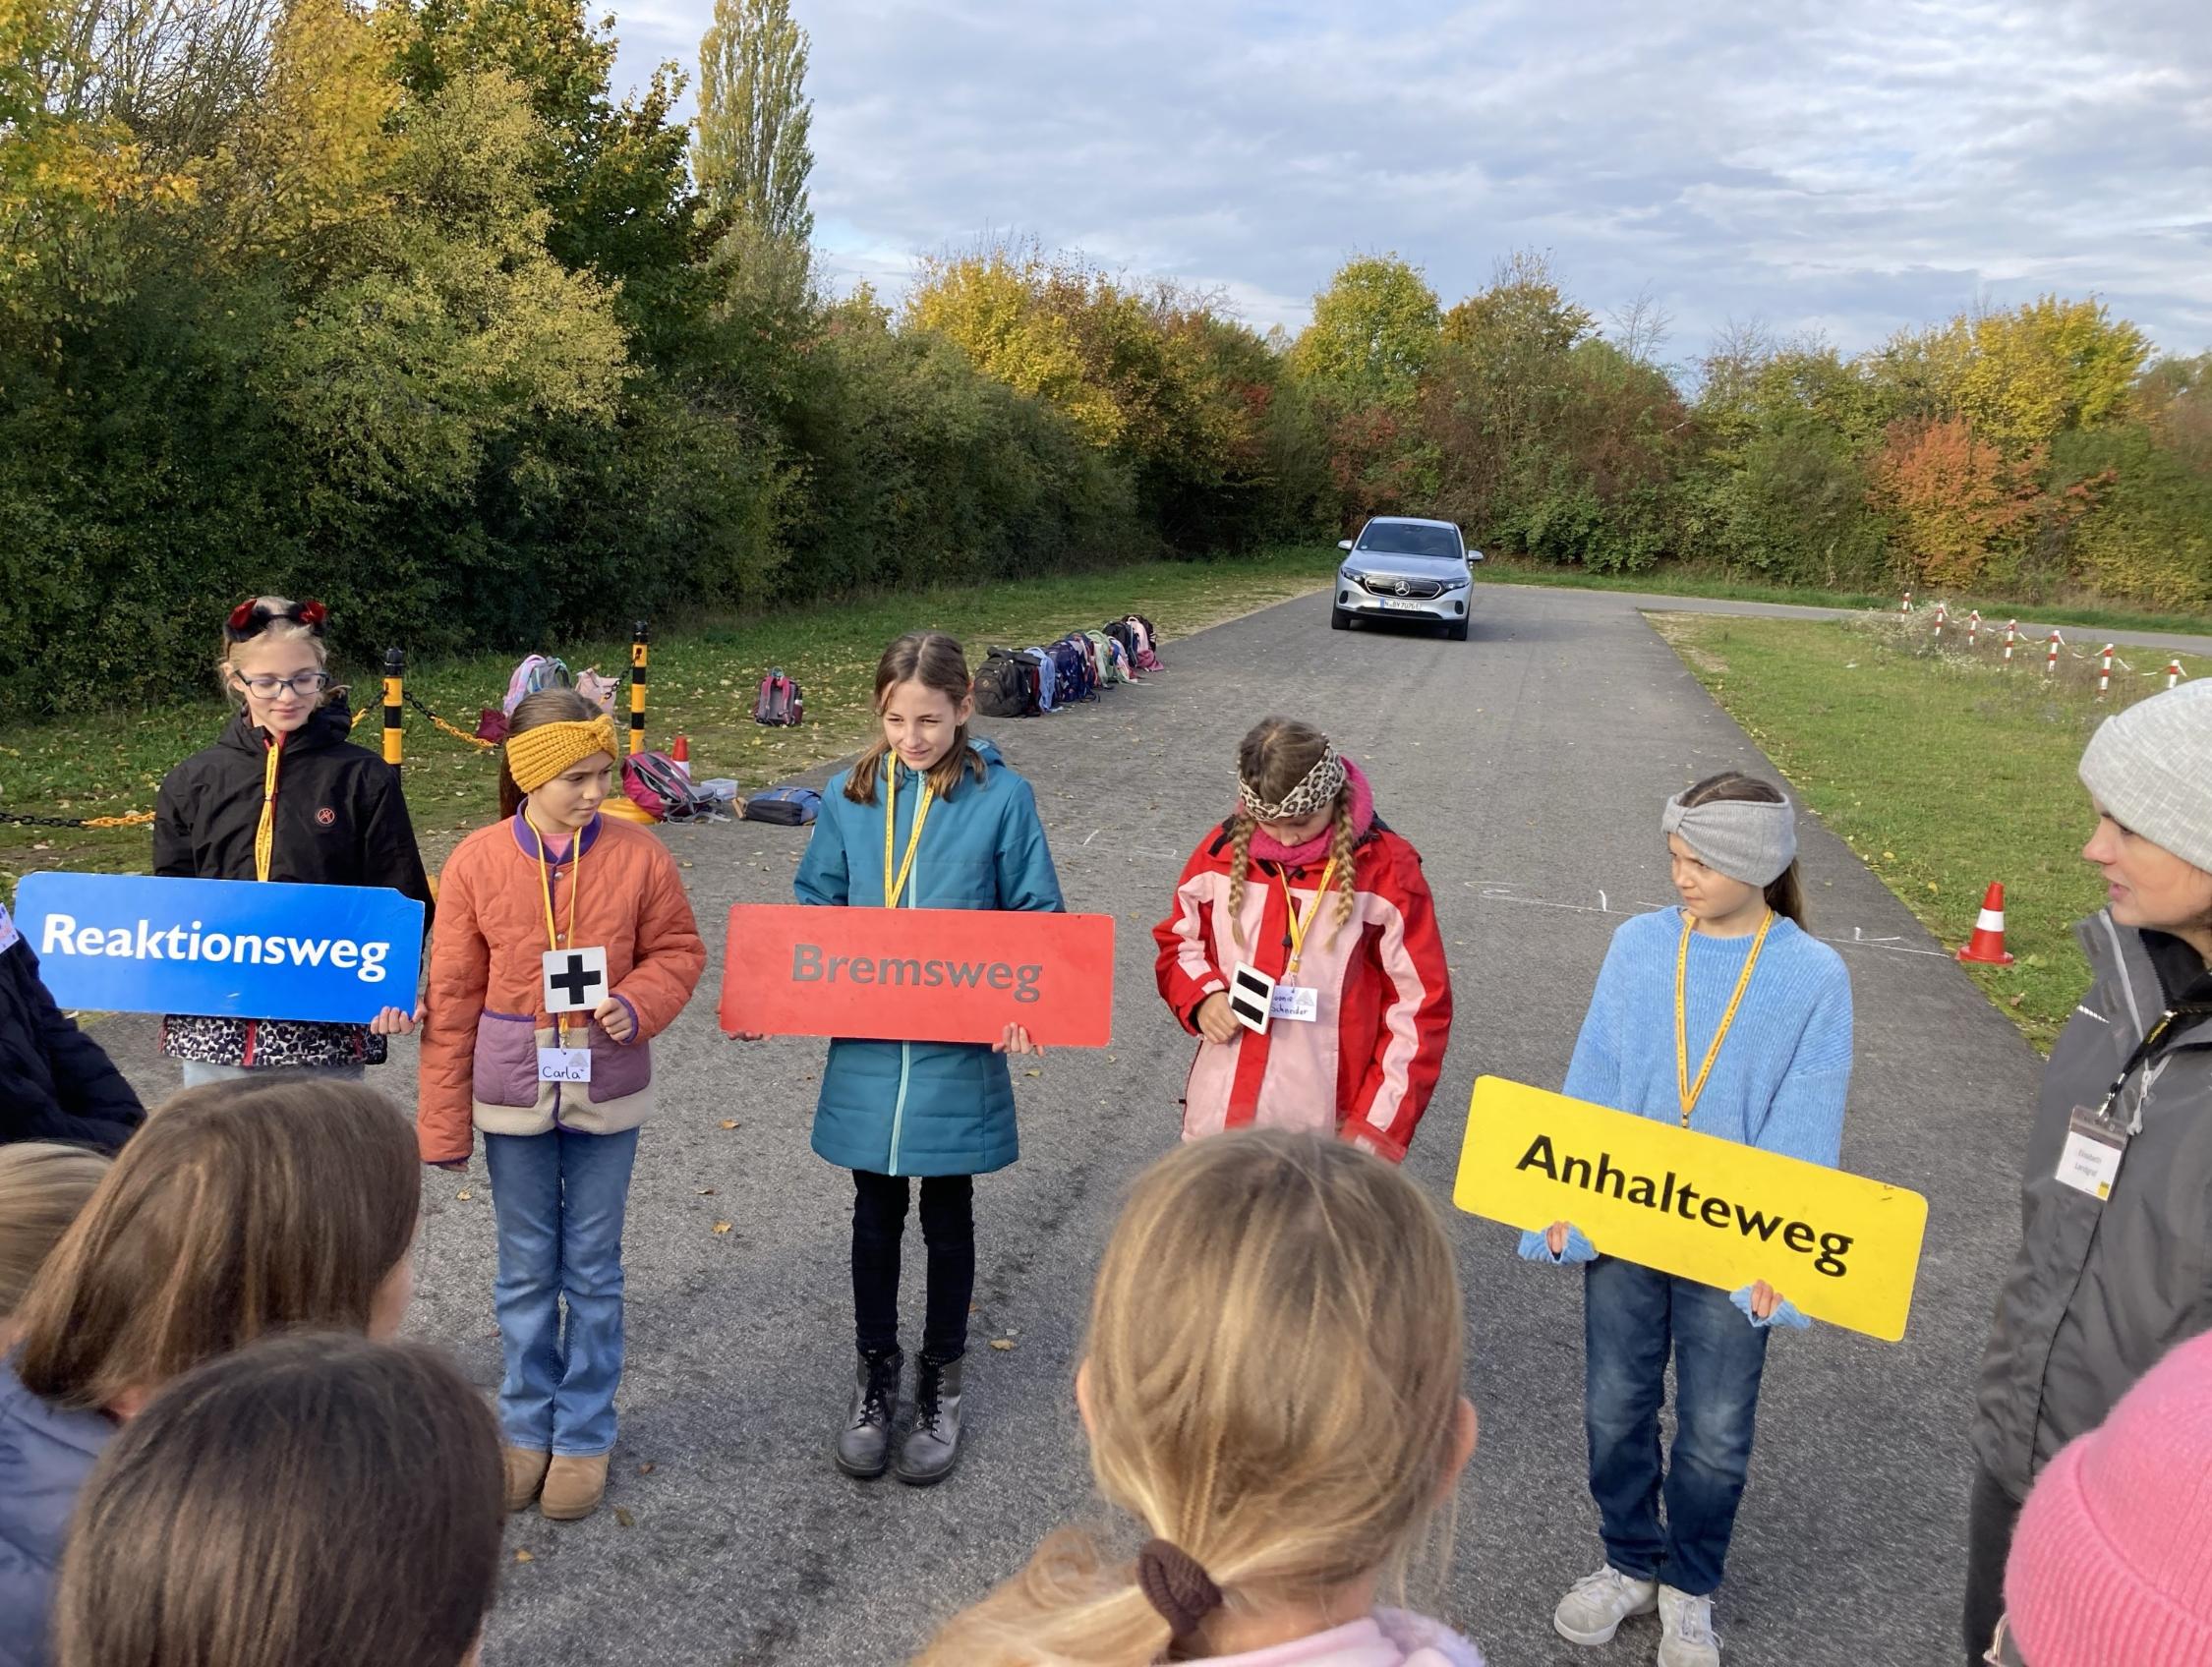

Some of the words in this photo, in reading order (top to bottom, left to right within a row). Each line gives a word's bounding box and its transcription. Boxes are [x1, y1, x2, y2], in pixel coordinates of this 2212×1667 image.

[42, 914, 389, 983] Reaktionsweg
[793, 944, 1043, 1003] Bremsweg
[542, 1066, 581, 1079] Carla
[1516, 1133, 1853, 1278] Anhalteweg
